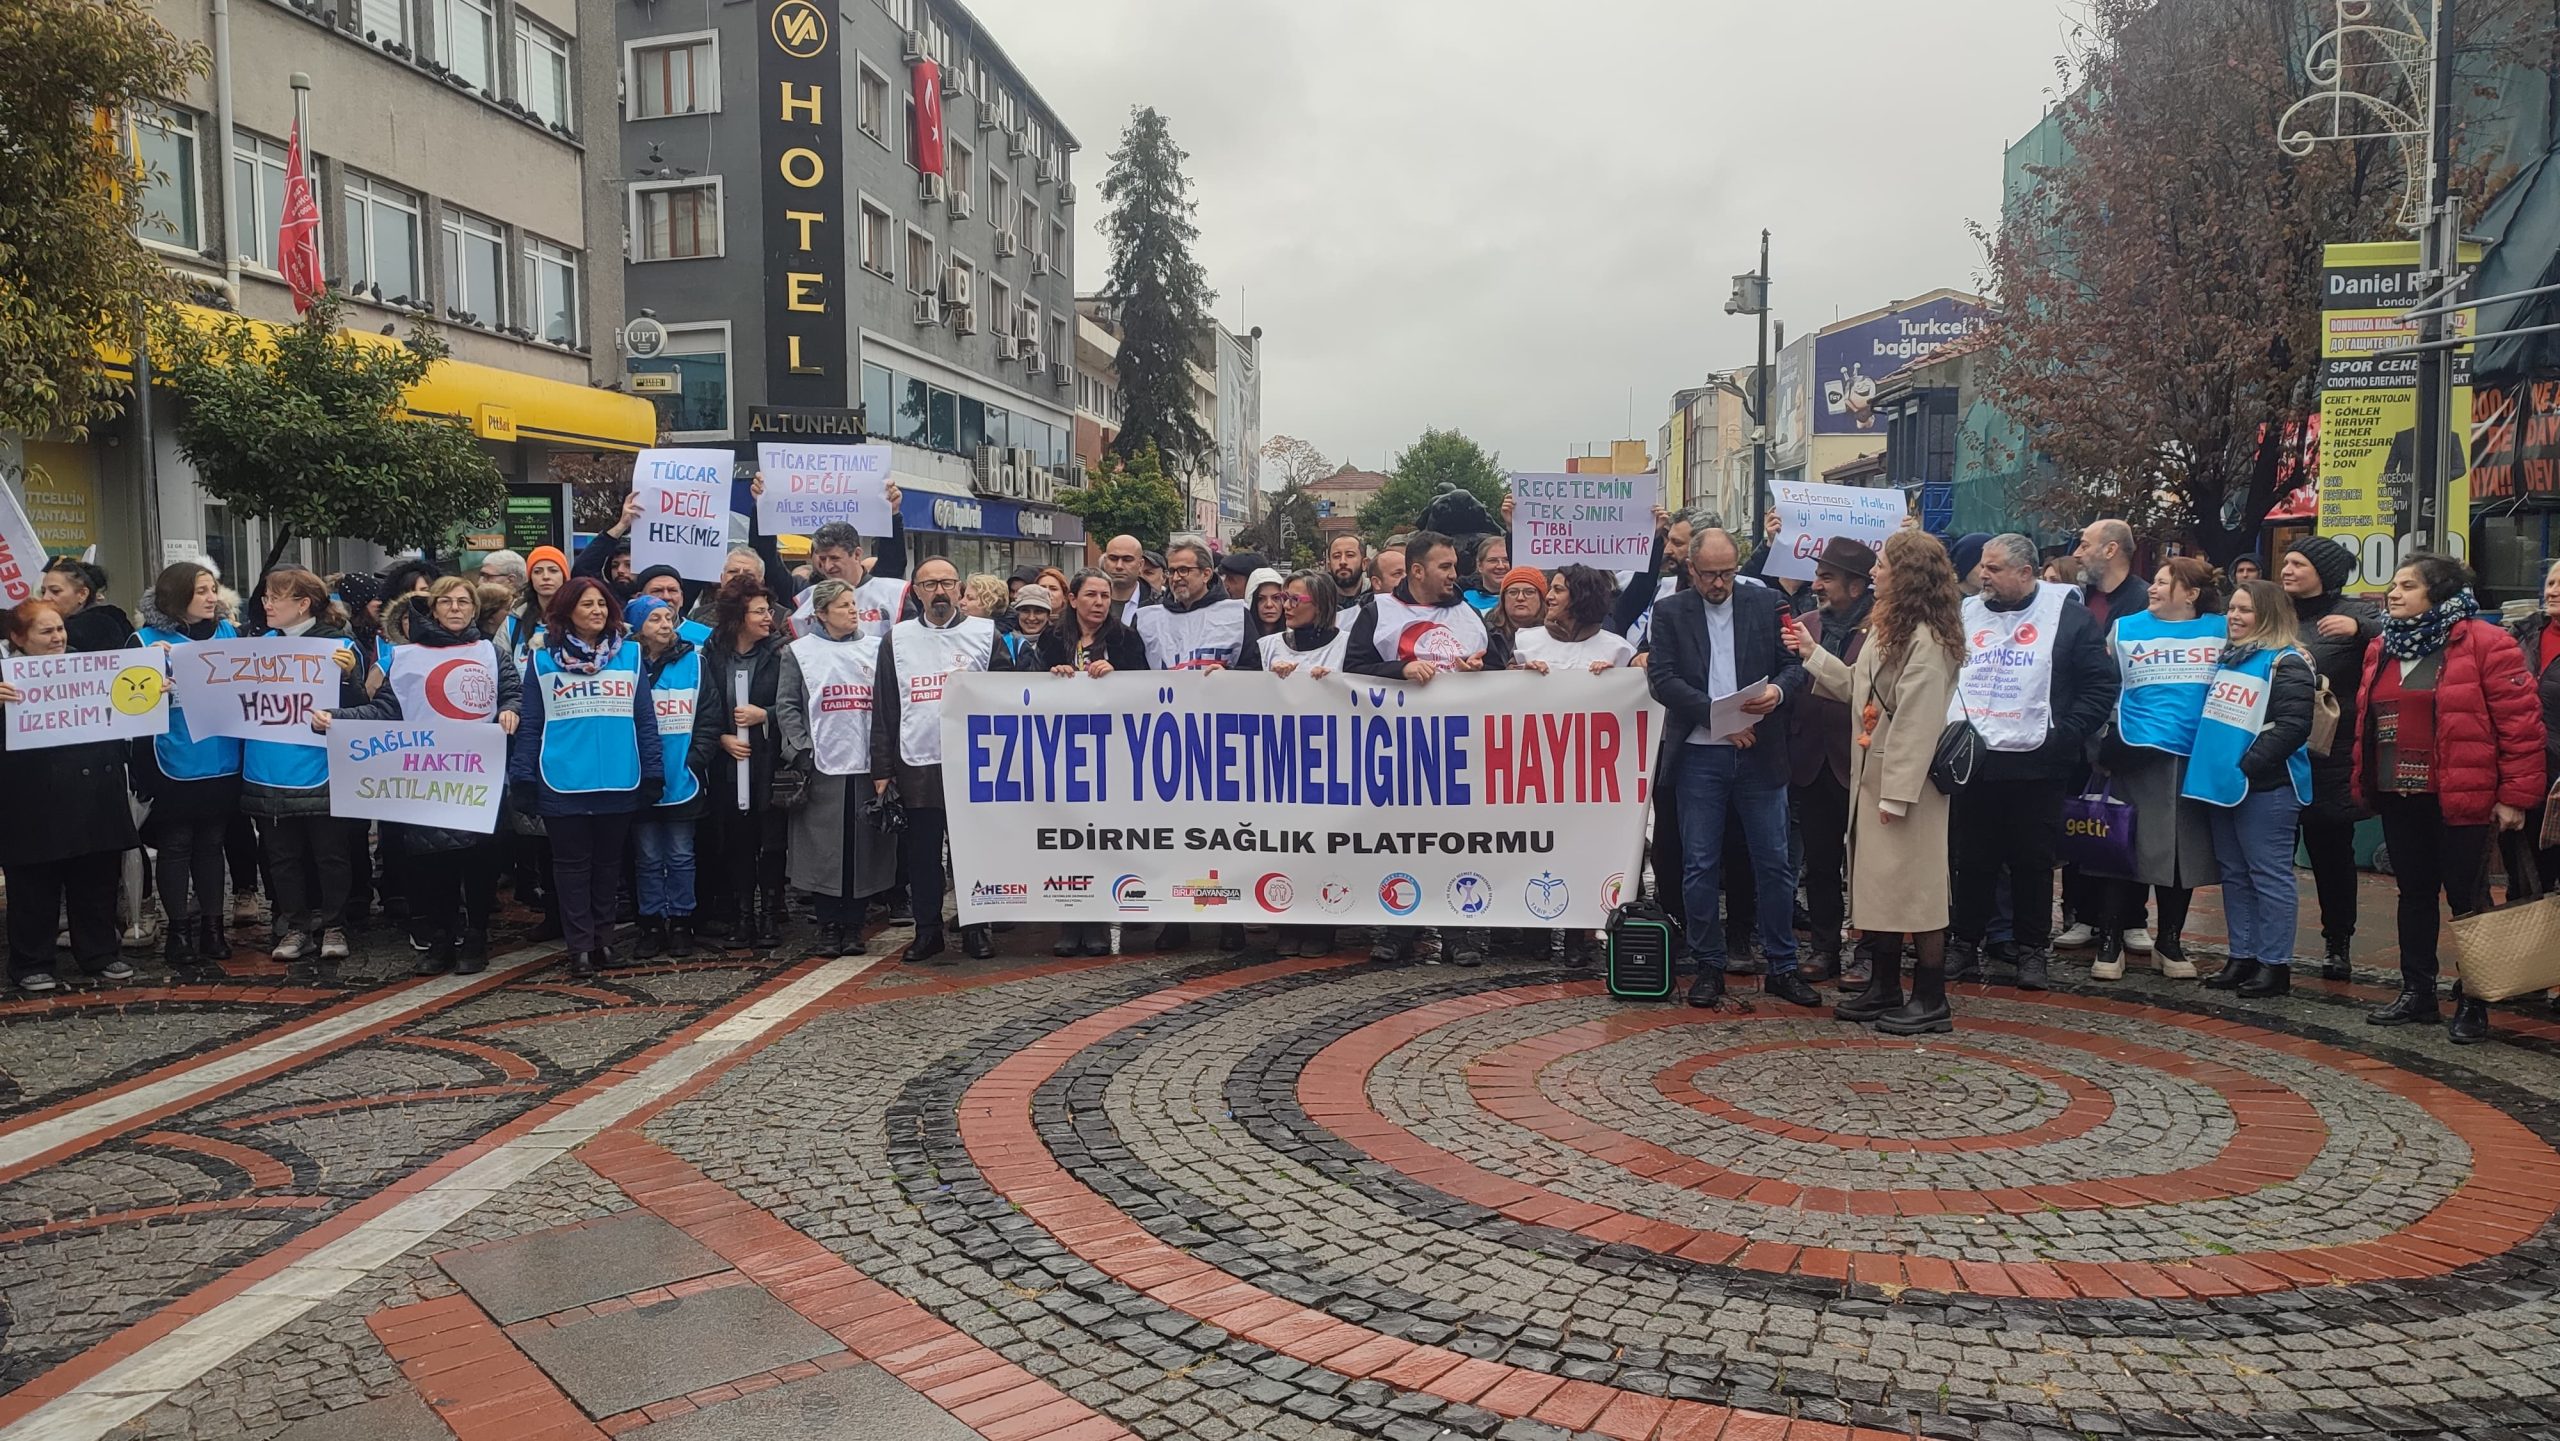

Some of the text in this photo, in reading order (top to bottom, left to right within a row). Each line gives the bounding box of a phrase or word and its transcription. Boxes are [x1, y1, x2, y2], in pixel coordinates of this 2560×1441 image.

[780, 81, 826, 376] HOTEL
[2330, 272, 2400, 294] Daniel
[2376, 296, 2419, 307] London
[630, 331, 659, 342] UPT
[1873, 338, 1942, 358] bağlan
[2330, 359, 2418, 373] SPOR CEKE
[2327, 376, 2368, 388] СПОРТНО
[2362, 393, 2411, 403] PANTOLON
[750, 413, 867, 435] ALTUNHAN
[650, 460, 721, 484] TÜCCAR
[2333, 460, 2357, 468] DON
[791, 474, 858, 494] DEĞİL
[1518, 479, 1632, 501] REÇETEMİN
[660, 489, 716, 519] DEĞİL
[776, 498, 859, 514] AİLE SAĞLIĞI
[1525, 502, 1623, 522] TEK SINIRI
[28, 509, 85, 522] VANTAJLI
[1797, 509, 1885, 528] iyi olma halinin
[649, 522, 720, 547] HEKİMİZ
[1531, 531, 1650, 556] GEREKLİLİKTİR
[13, 655, 120, 680] REÇETEME
[822, 685, 872, 698] EDİRN
[912, 689, 940, 700] TABİP
[657, 700, 693, 716] SEN
[823, 701, 851, 711] TABİP
[349, 730, 435, 761] SAĞLIK
[967, 688, 1112, 803] EZİYET
[1122, 687, 1471, 807] YÖNETMELİĞİNE
[1484, 711, 1622, 804] HAYIR
[355, 776, 490, 808] SATILAMAZ
[2065, 818, 2110, 837] getir
[1037, 822, 1554, 854] EDİRNE SAĞLIK PLATFORMU
[971, 880, 1027, 896] AHESEN
[1044, 875, 1095, 891] AHEF
